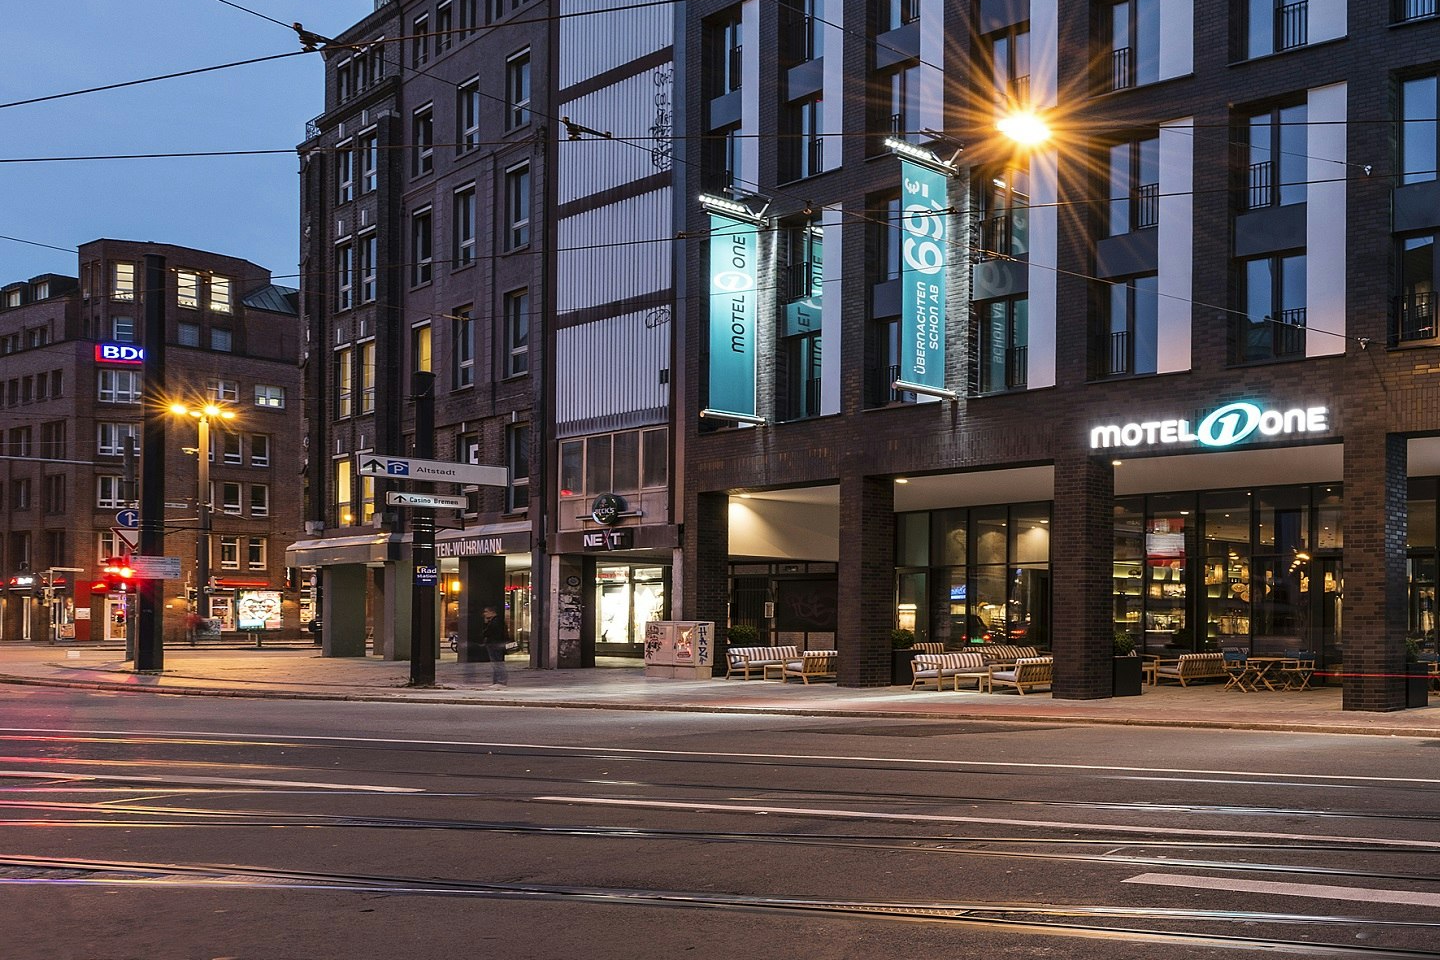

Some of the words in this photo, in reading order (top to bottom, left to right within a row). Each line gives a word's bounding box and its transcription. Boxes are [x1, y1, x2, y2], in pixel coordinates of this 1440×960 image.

[731, 235, 746, 269] ONE
[929, 284, 939, 299] AB
[731, 295, 746, 354] MOTEL
[912, 281, 926, 375] ÜBERNACHTEN
[929, 301, 939, 350] SCHON
[1091, 419, 1198, 448] MOTEL
[1259, 406, 1327, 435] ONE
[416, 466, 456, 476] Altstadt
[409, 496, 432, 504] Casino
[433, 497, 459, 505] Bremen
[434, 538, 502, 557] TEN-WÜHRMANN
[583, 528, 621, 550] NEXT
